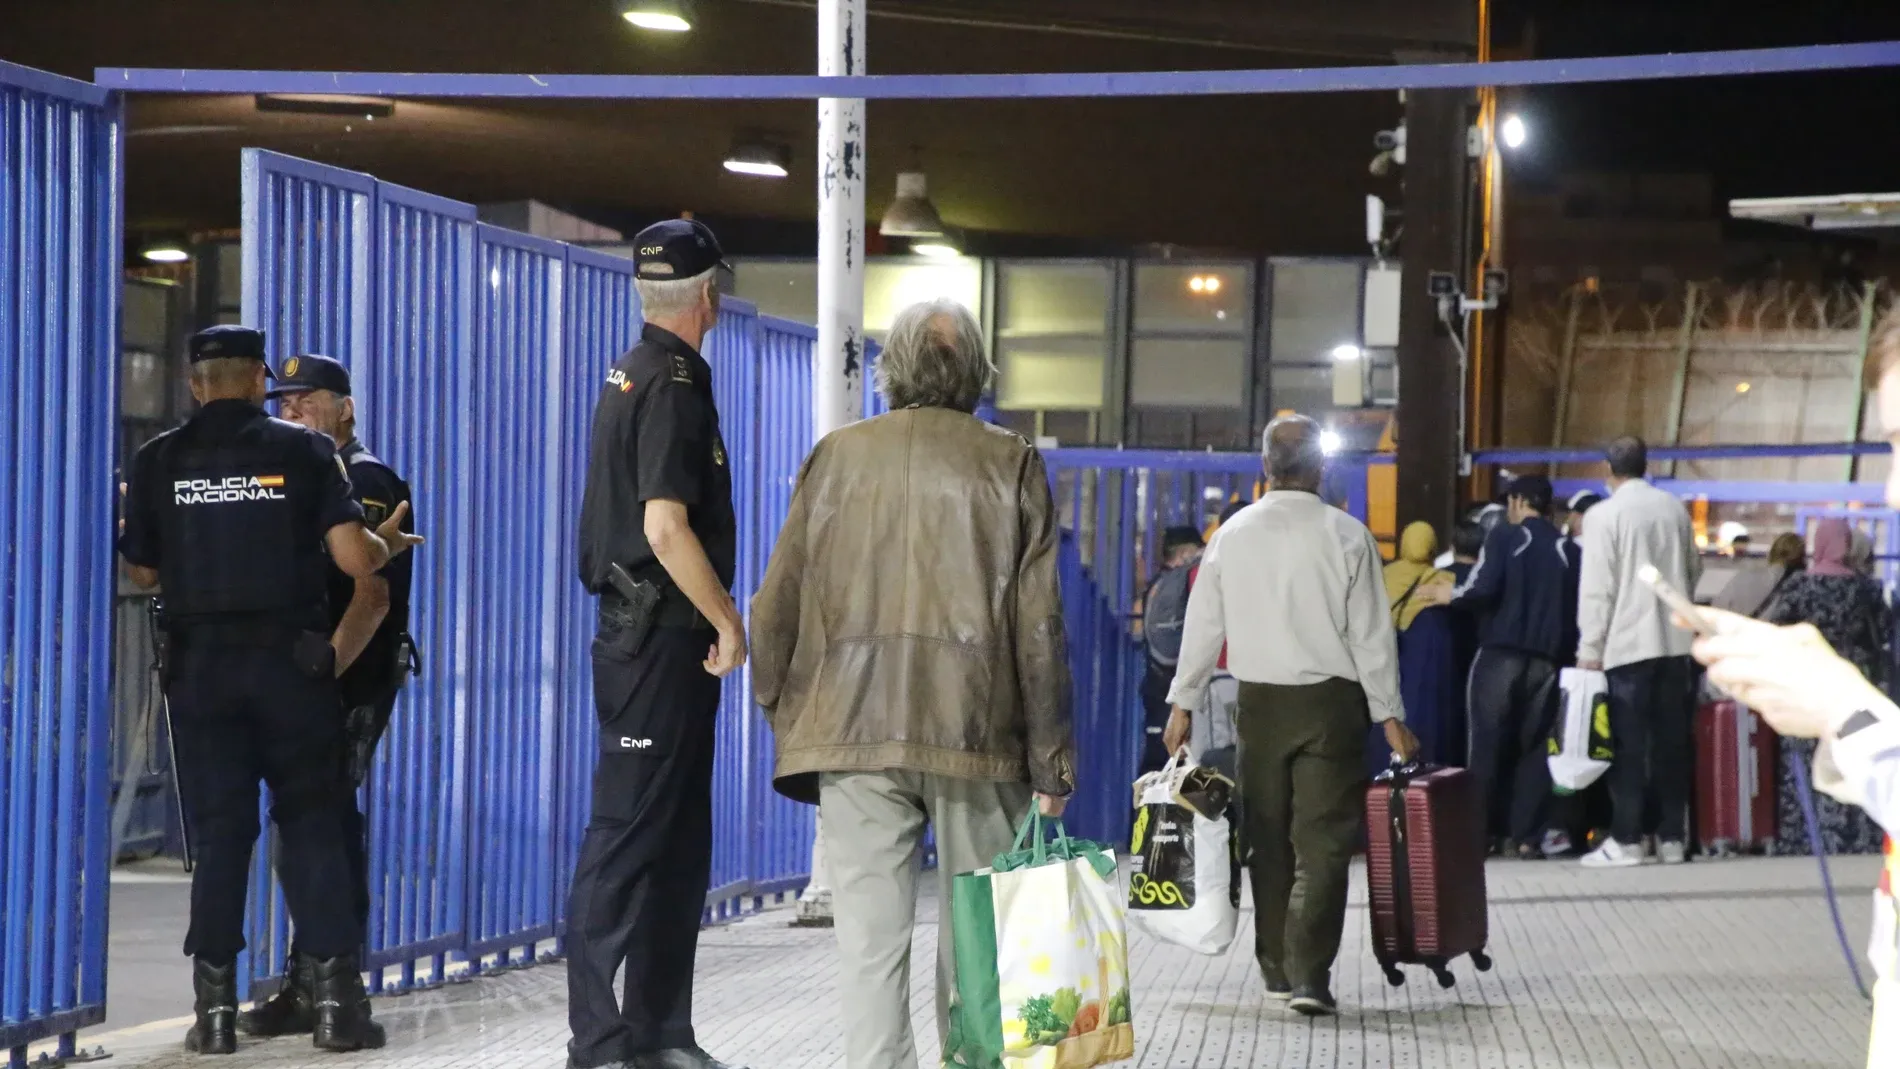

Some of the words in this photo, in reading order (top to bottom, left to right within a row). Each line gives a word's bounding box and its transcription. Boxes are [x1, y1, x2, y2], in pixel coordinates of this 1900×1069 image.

[640, 246, 663, 255] CNP
[174, 476, 262, 492] POLICIA
[175, 488, 285, 505] NACIONAL
[620, 736, 653, 749] CNP
